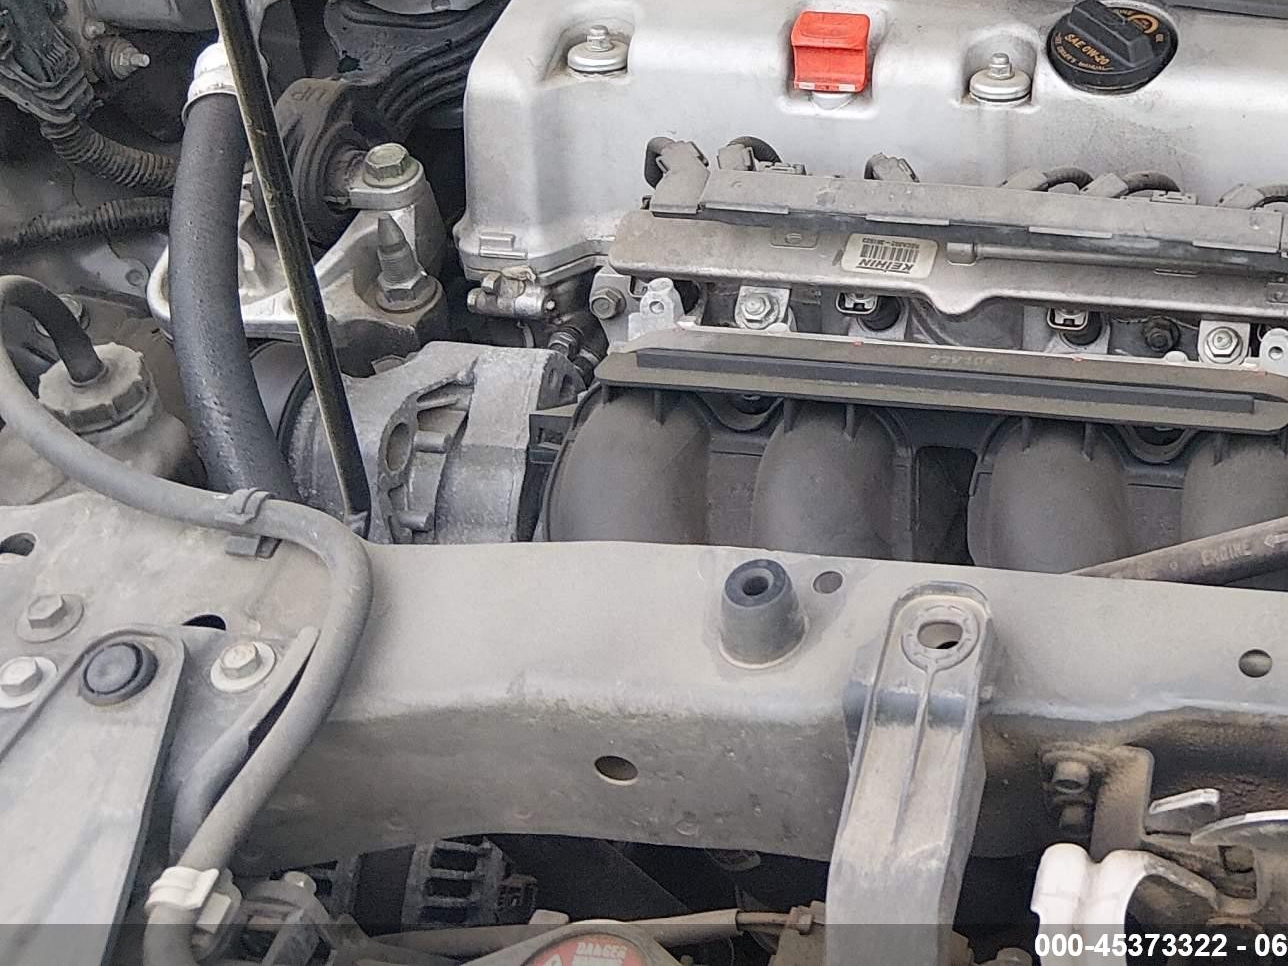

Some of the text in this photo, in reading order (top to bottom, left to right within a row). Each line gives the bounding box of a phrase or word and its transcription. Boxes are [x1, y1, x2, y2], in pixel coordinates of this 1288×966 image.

[1064, 33, 1110, 65] SAE 0W-20
[859, 258, 914, 272] KEIHIN
